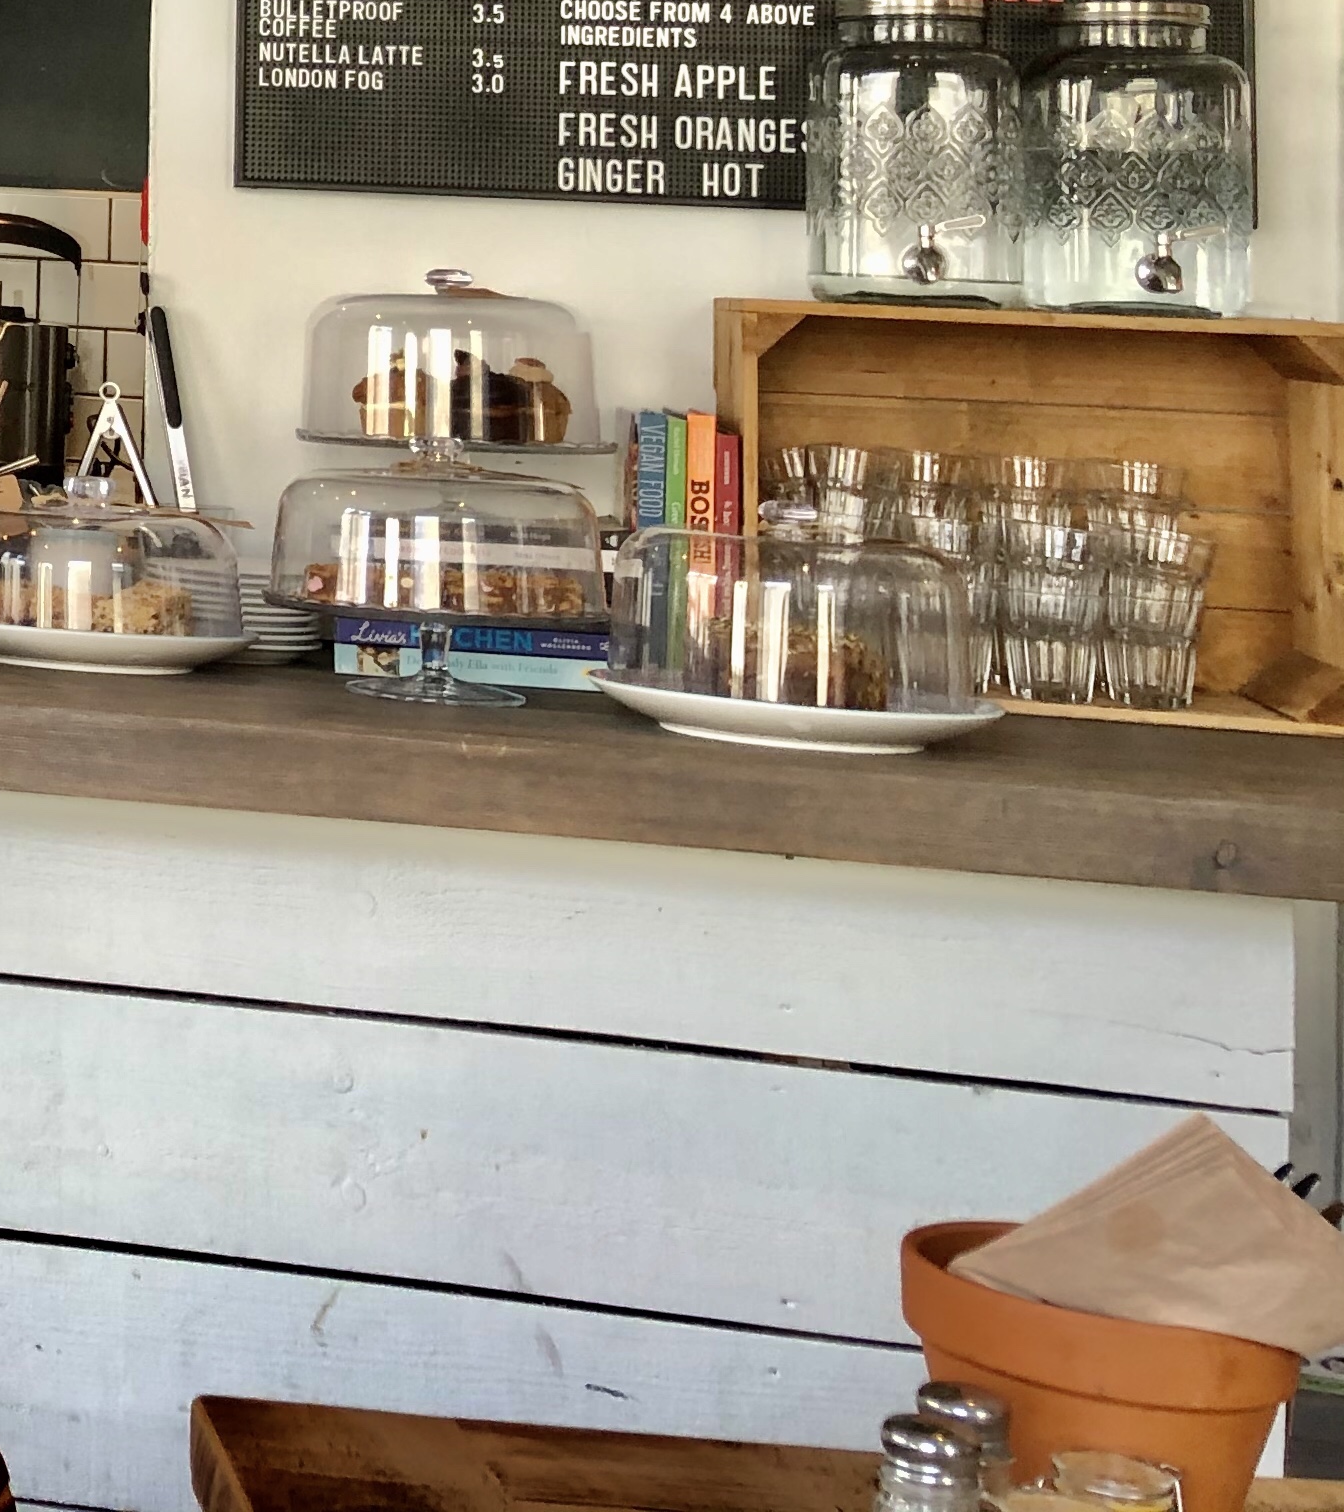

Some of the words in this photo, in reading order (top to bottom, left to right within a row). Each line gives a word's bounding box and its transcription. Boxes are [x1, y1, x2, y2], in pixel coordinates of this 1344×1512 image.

[259, 0, 404, 21] BULLETPROOF
[559, 60, 659, 98] FRESH
[674, 63, 777, 101] APPLE
[557, 157, 665, 195] GINGER
[702, 162, 765, 198] HOT
[638, 424, 666, 473] VEGAN
[638, 478, 664, 518] FOOD
